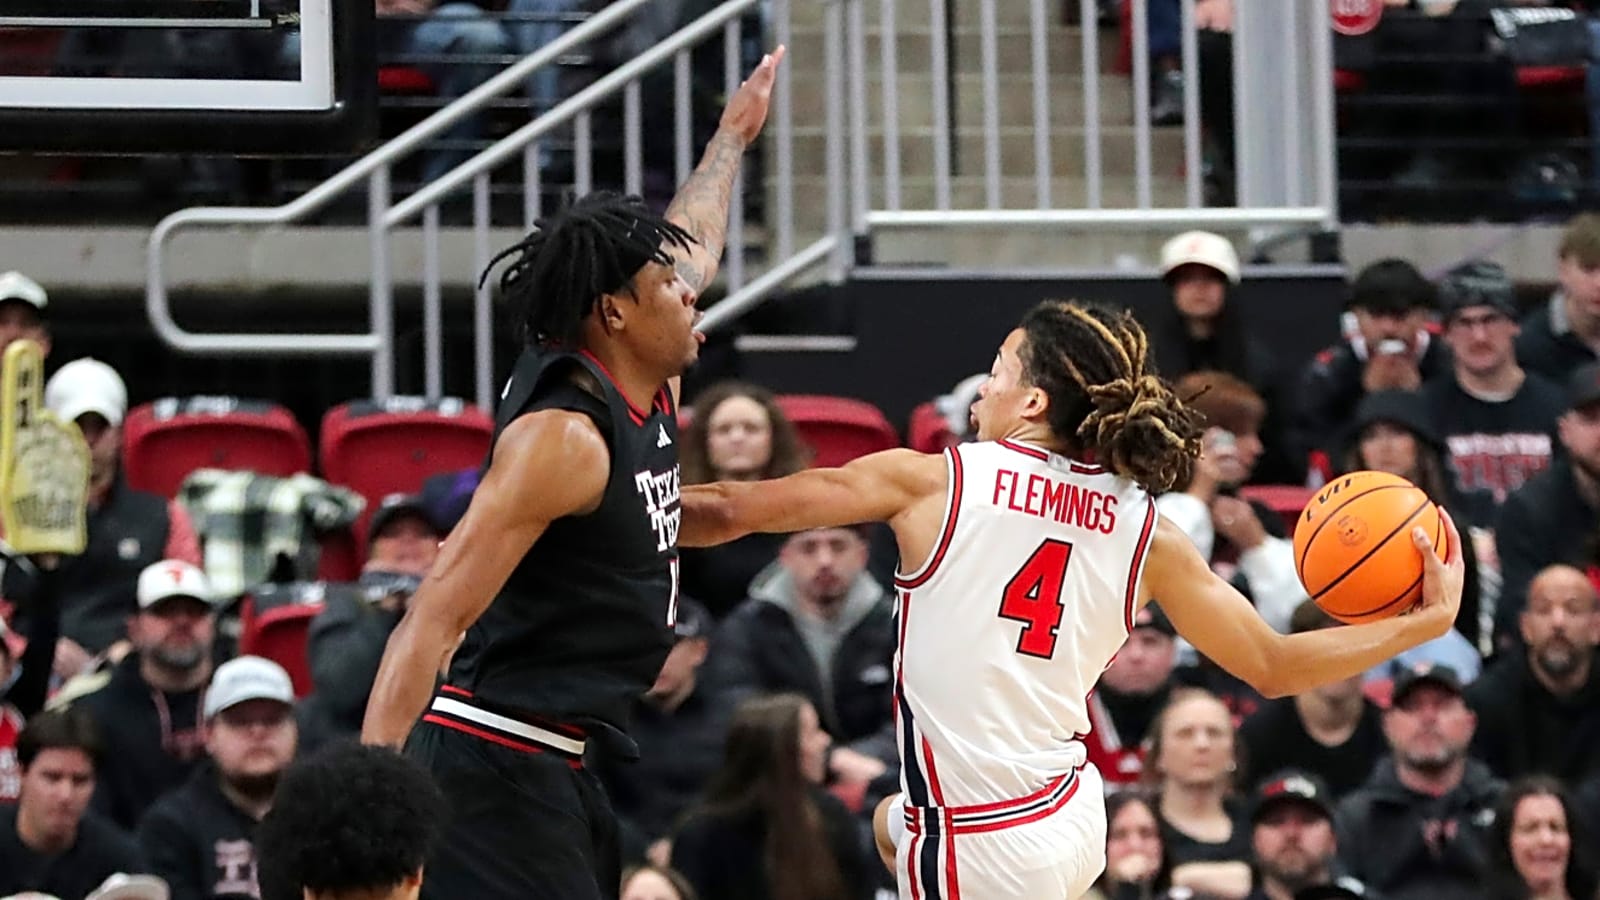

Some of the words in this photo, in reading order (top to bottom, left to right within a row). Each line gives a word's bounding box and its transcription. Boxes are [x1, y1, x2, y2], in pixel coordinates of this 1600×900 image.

[635, 464, 681, 514] TEXA
[992, 469, 1118, 534] FLEMINGS
[650, 507, 682, 552] TEC
[667, 556, 680, 627] 1
[998, 537, 1073, 660] 4
